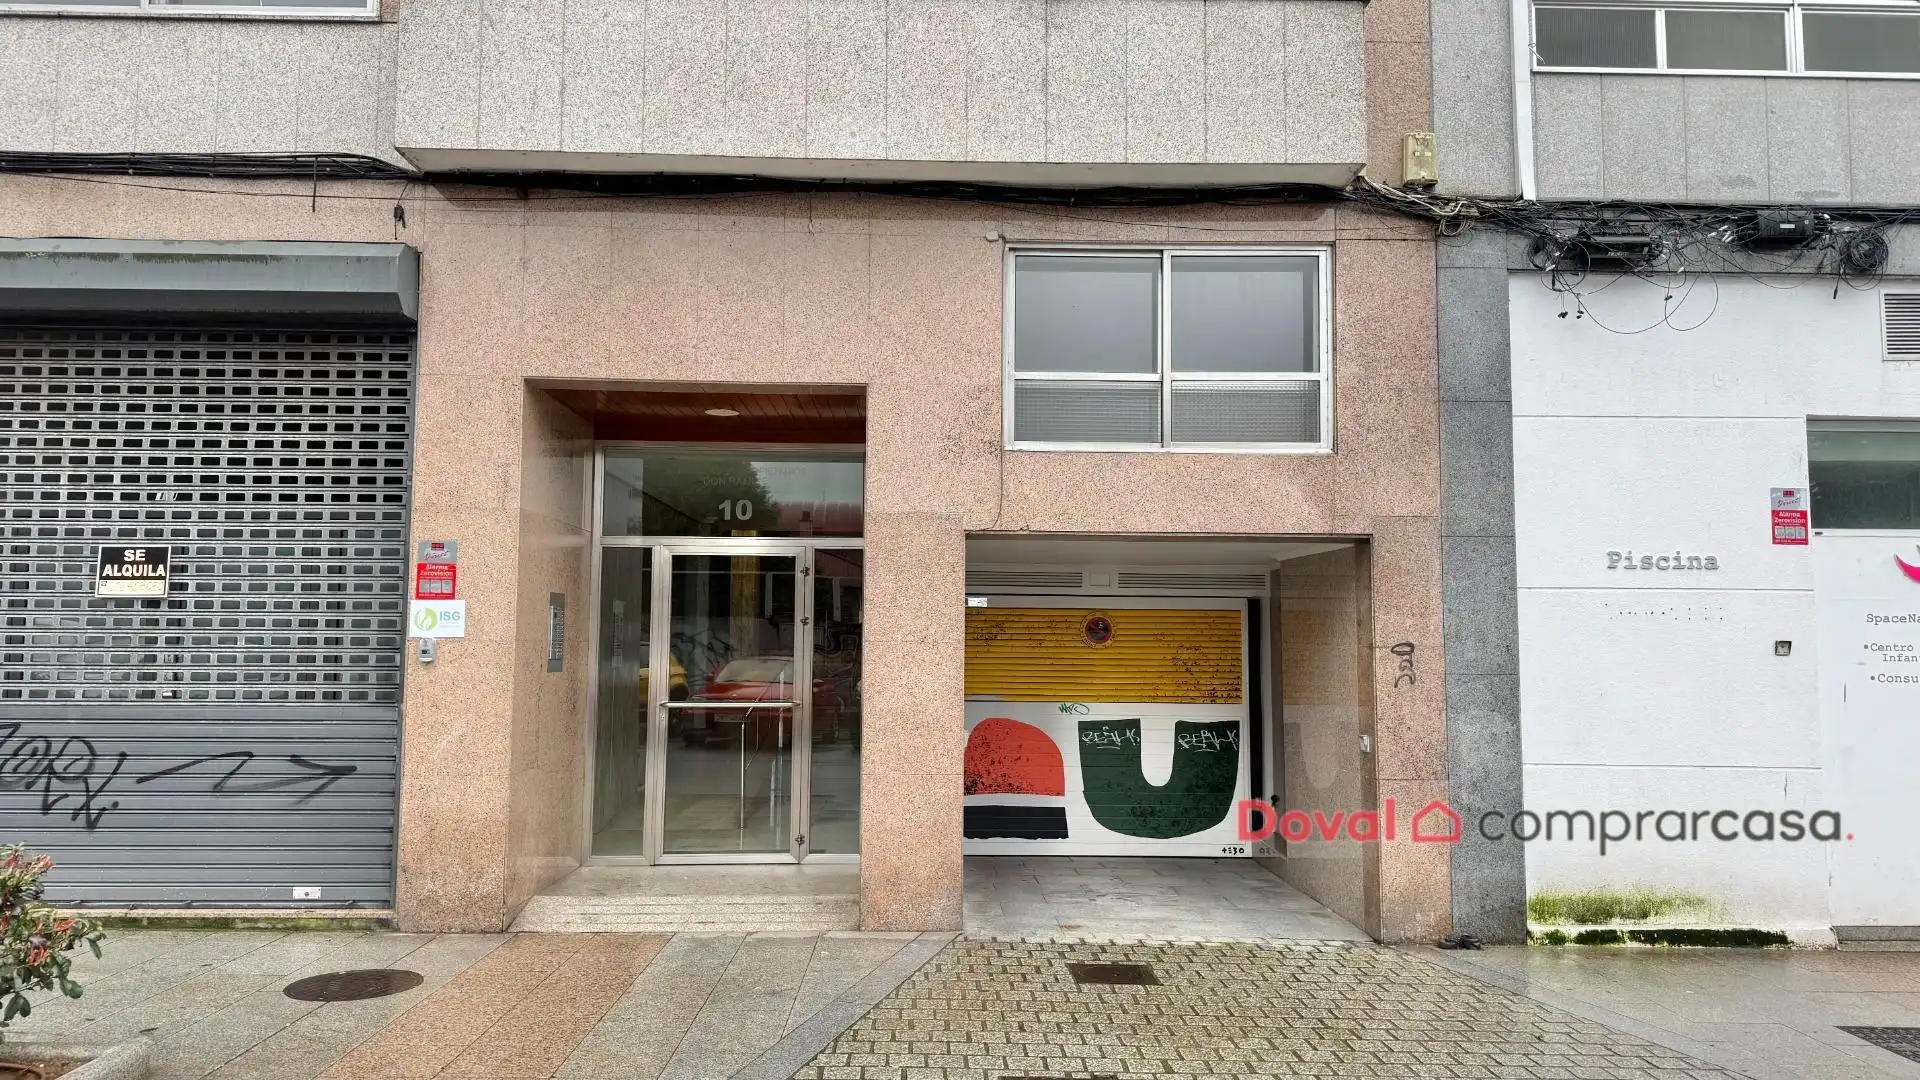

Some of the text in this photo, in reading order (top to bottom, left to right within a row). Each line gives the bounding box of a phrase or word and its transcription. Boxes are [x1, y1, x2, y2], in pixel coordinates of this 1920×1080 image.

[719, 500, 753, 521] 10
[124, 549, 146, 562] SE
[1606, 550, 1720, 571] Piscina
[102, 564, 166, 577] ALQUILA
[440, 611, 460, 621] ISG
[1870, 642, 1914, 652] Centro
[1882, 653, 1920, 662] Infan
[1877, 673, 1920, 683] Consu
